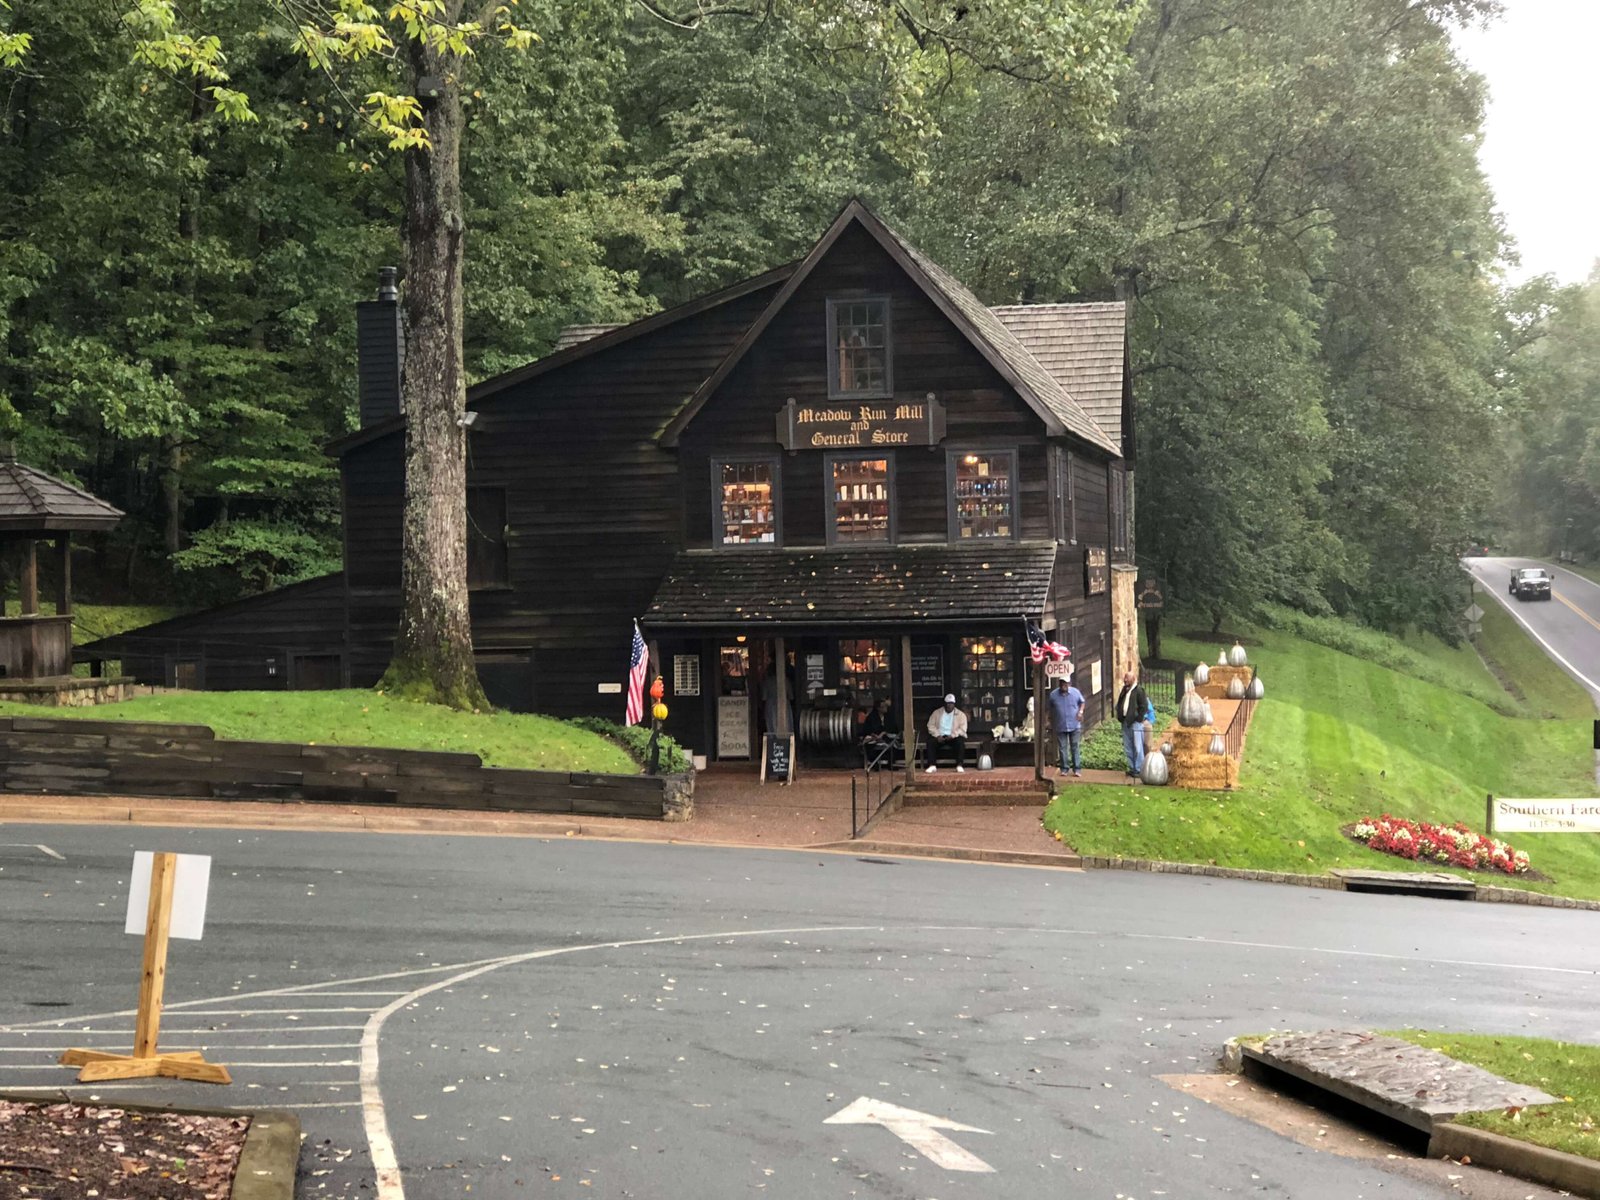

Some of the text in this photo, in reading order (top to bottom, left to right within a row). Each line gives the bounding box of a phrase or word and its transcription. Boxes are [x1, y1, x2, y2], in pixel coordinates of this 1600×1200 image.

[797, 405, 923, 424] Meadow Run Mill
[850, 419, 870, 431] and
[811, 428, 909, 446] General Store
[1047, 663, 1070, 675] OPEN
[720, 742, 748, 750] SODA
[1500, 802, 1564, 815] Southern
